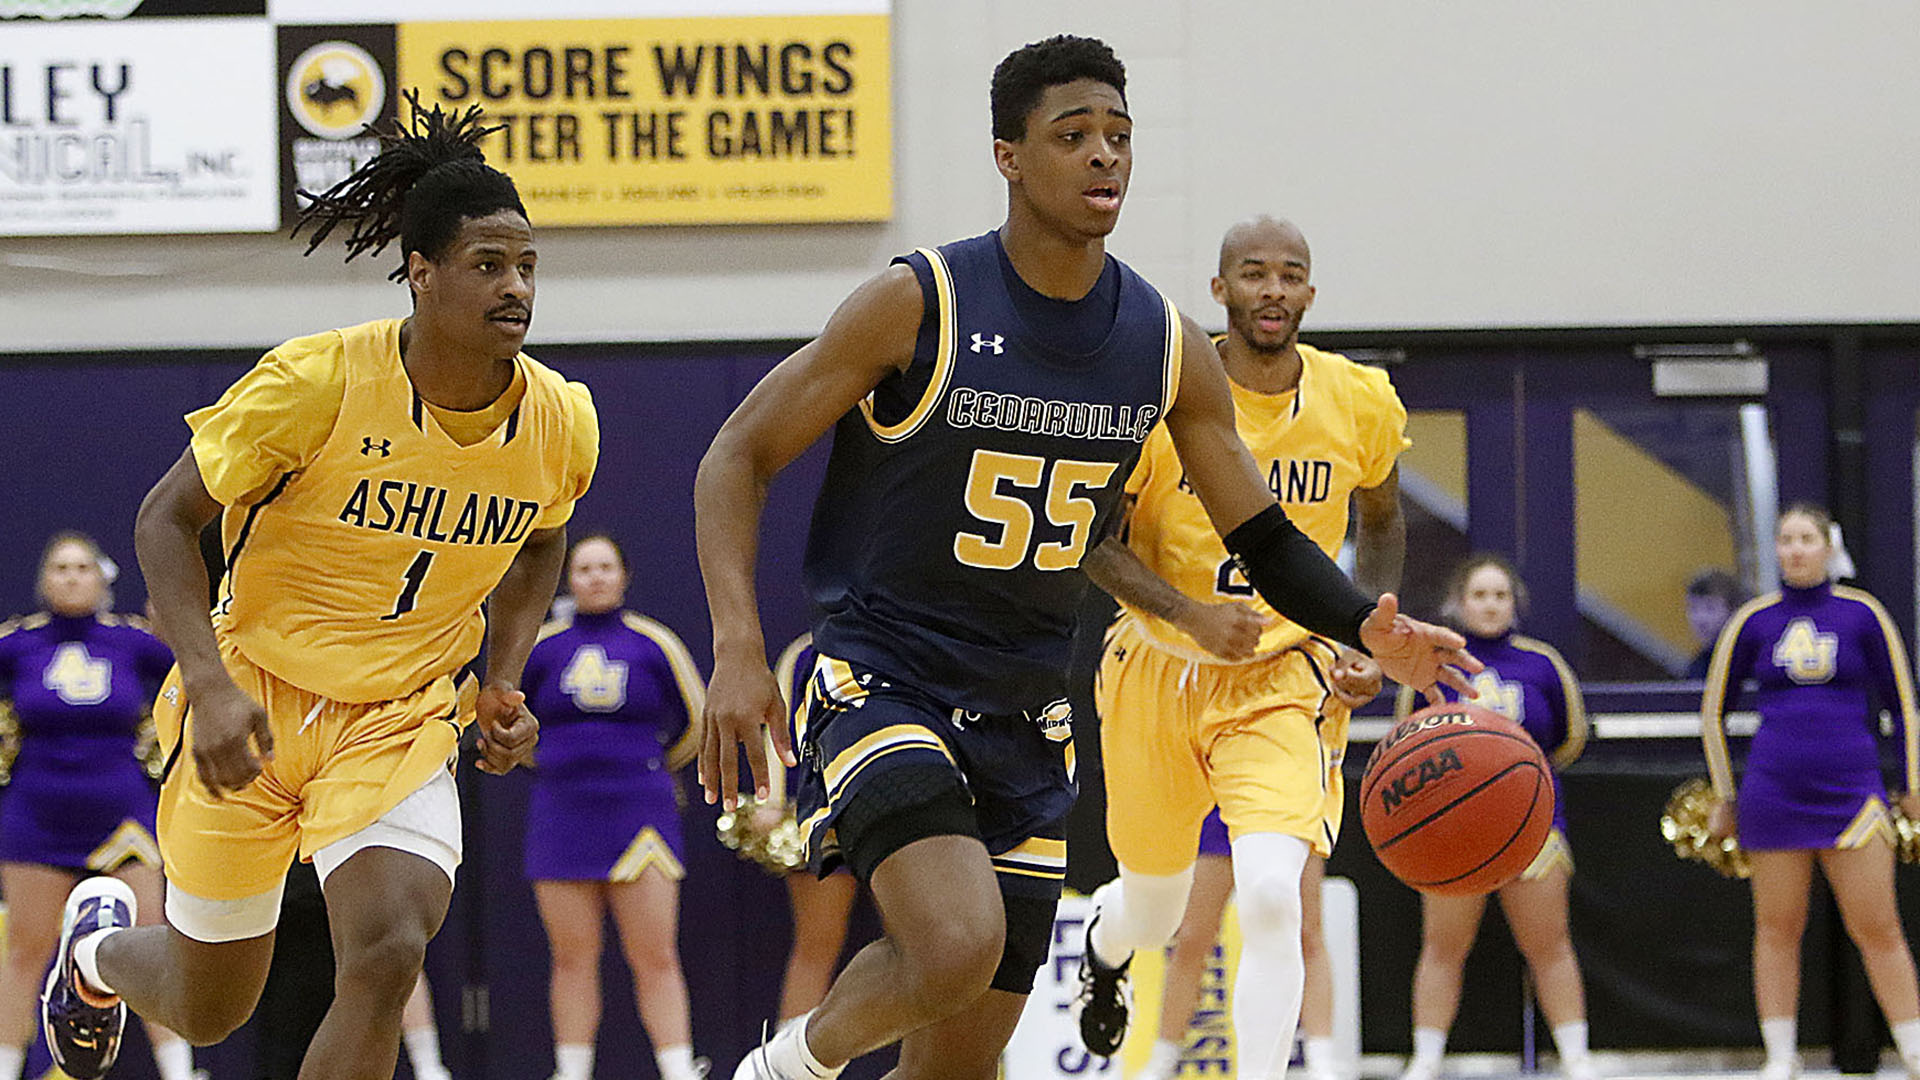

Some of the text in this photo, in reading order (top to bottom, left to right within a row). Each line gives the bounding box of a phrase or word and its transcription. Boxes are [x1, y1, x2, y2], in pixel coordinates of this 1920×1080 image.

[438, 42, 854, 100] SCORE WINGS
[473, 108, 855, 162] TER THE GAME!
[947, 387, 1159, 443] CEDARVILLE
[337, 477, 540, 546] ASHLAND
[953, 448, 1120, 571] 55
[379, 549, 434, 621] 1
[1380, 746, 1465, 817] NCAA
